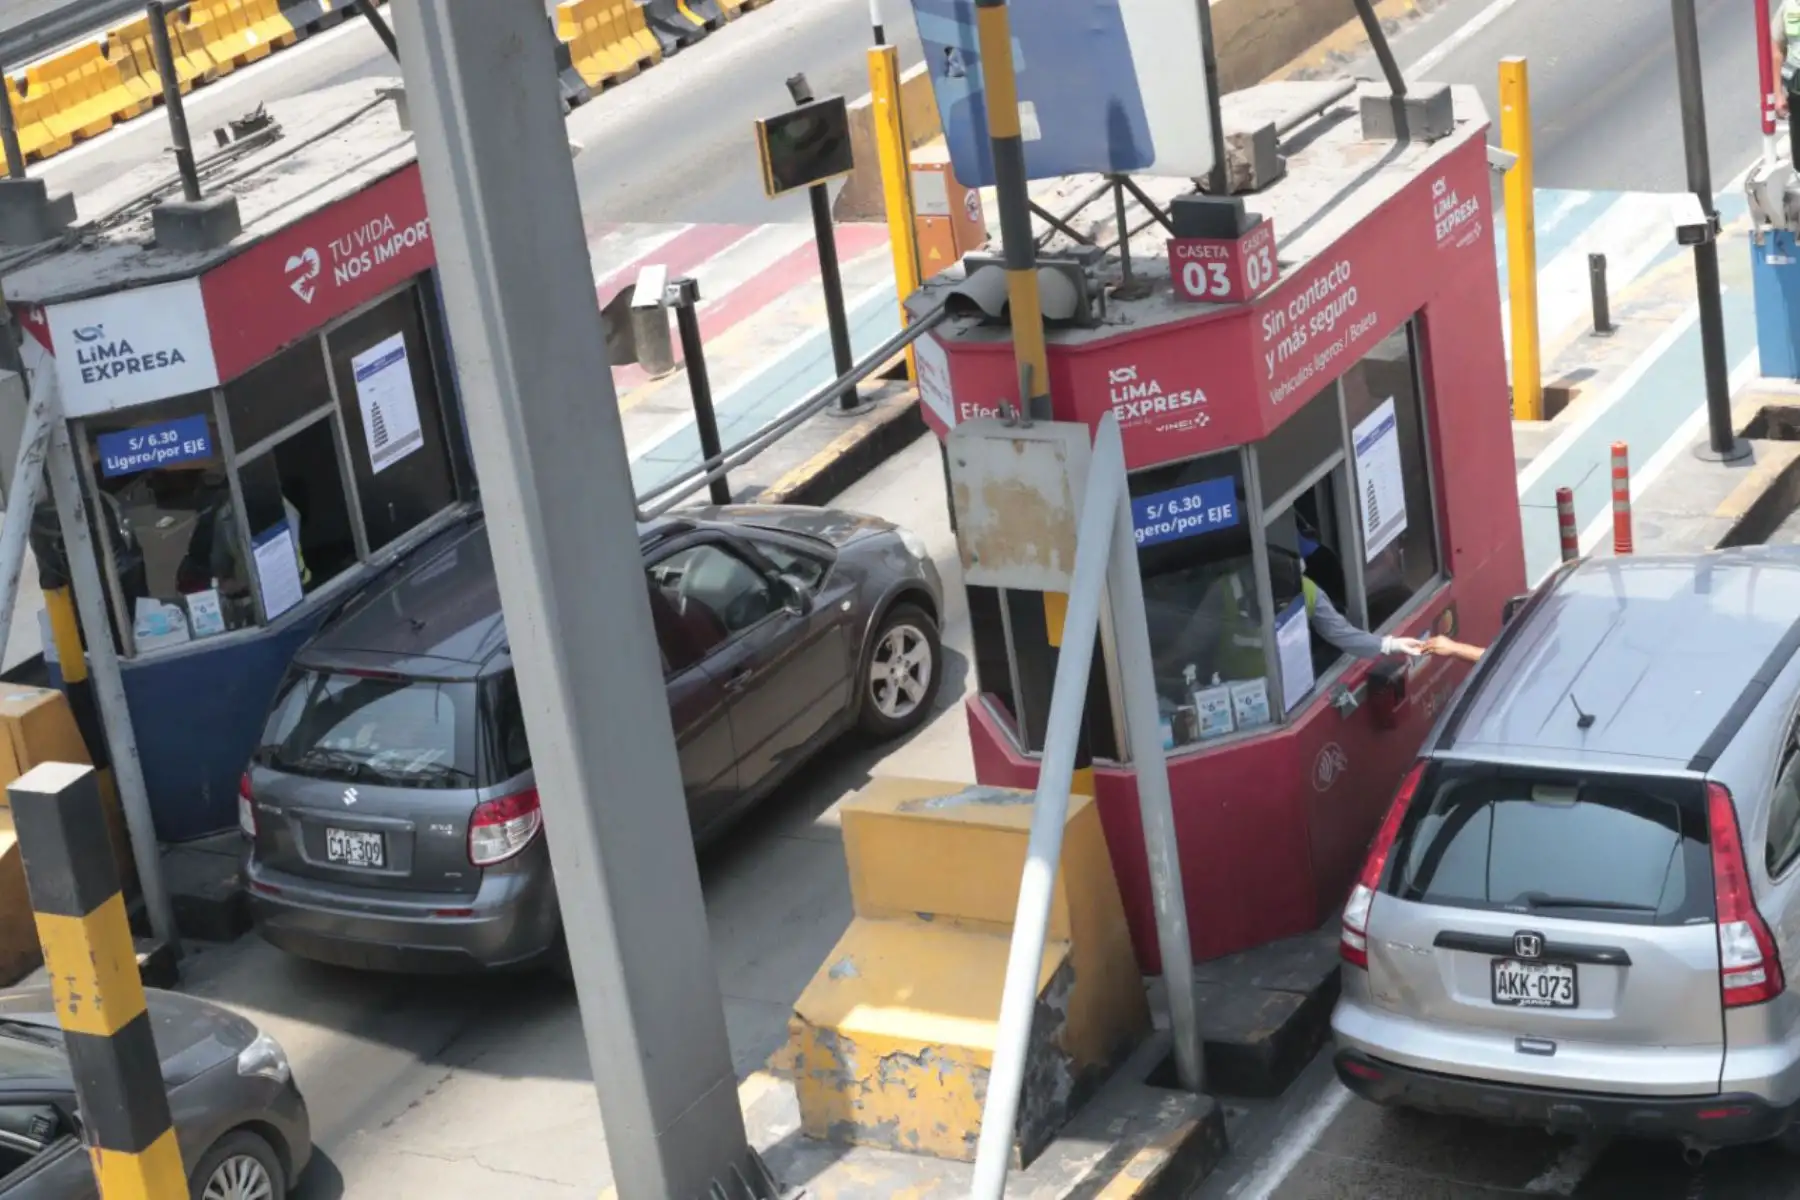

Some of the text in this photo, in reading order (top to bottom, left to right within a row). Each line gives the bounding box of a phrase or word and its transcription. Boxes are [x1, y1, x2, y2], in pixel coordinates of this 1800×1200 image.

[1436, 194, 1479, 241] EXPRESA
[328, 213, 395, 262] TU VIDA
[1176, 244, 1229, 259] CASETA
[1242, 227, 1269, 254] CASETA
[334, 252, 372, 286] NOS
[1183, 262, 1231, 296] 03
[1246, 244, 1273, 289] 03
[1262, 260, 1351, 342] Sin contacto
[1265, 286, 1358, 380] y más seguro
[81, 348, 186, 384] EXPRESA
[1113, 388, 1207, 421] EXPRESA
[107, 438, 206, 471] Ligero/por EJE
[148, 430, 178, 446] 6.30
[1168, 495, 1202, 515] 6.30
[1135, 503, 1233, 543] gero/por EJE
[1498, 970, 1572, 1000] AKK-073
